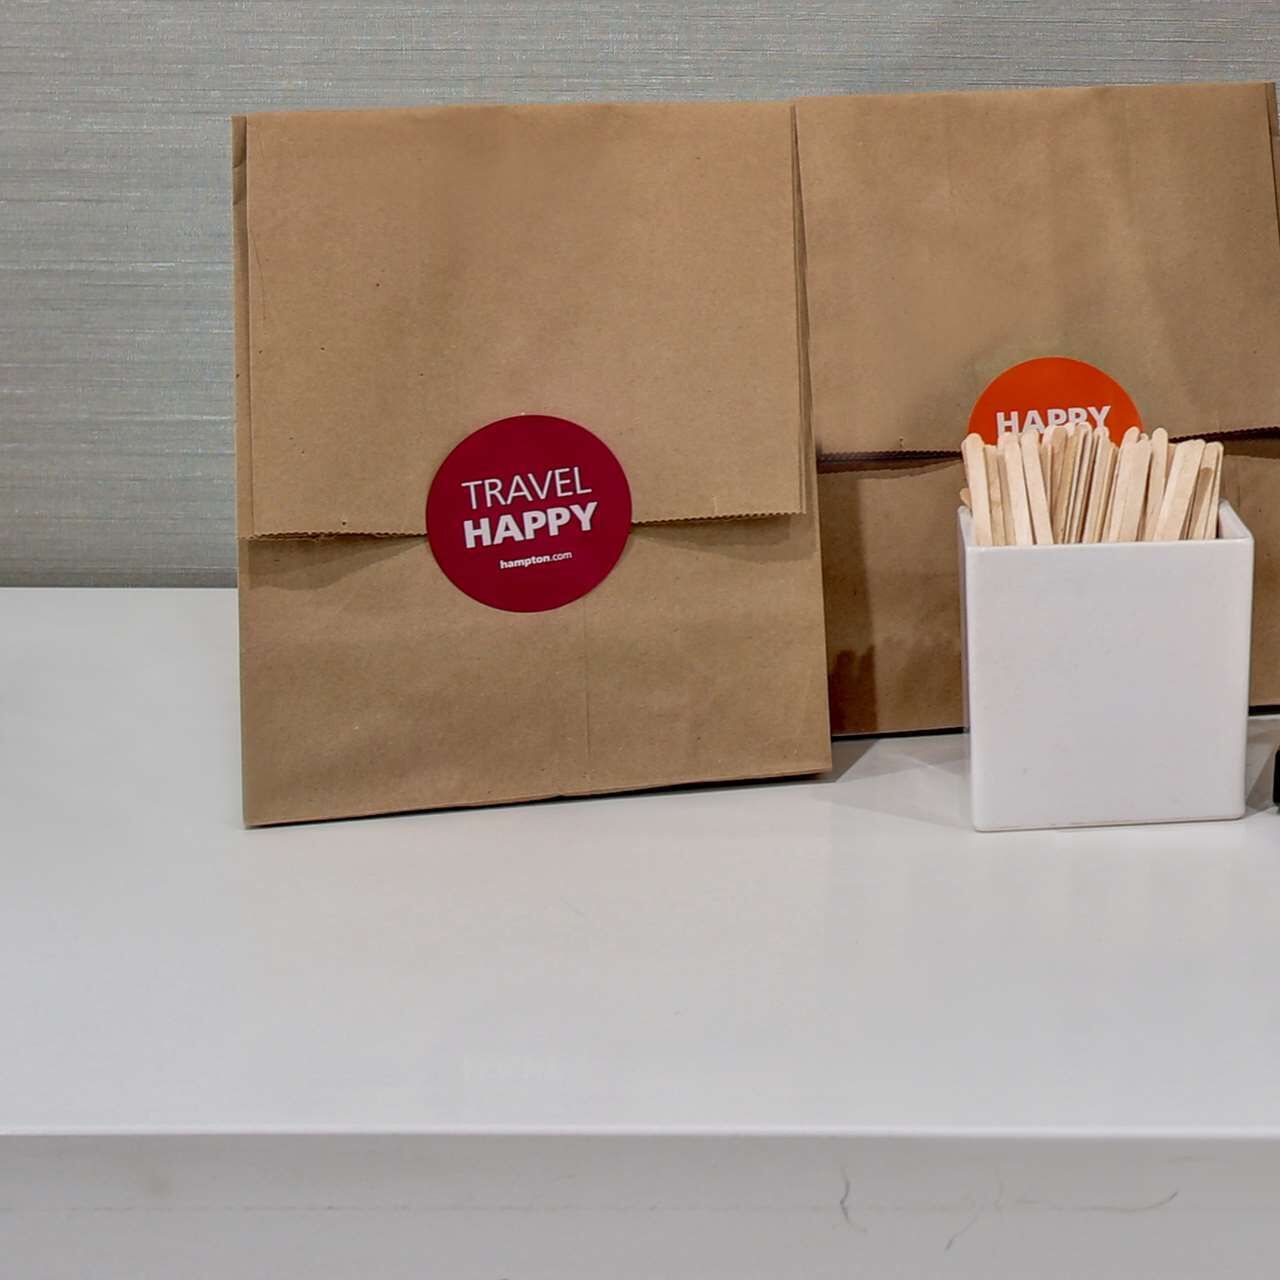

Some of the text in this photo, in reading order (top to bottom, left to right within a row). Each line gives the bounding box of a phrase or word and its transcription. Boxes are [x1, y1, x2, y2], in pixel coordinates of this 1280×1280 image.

[461, 466, 592, 510] TRAVEL
[463, 501, 598, 549] HAPPY
[499, 551, 573, 569] hampton.com
